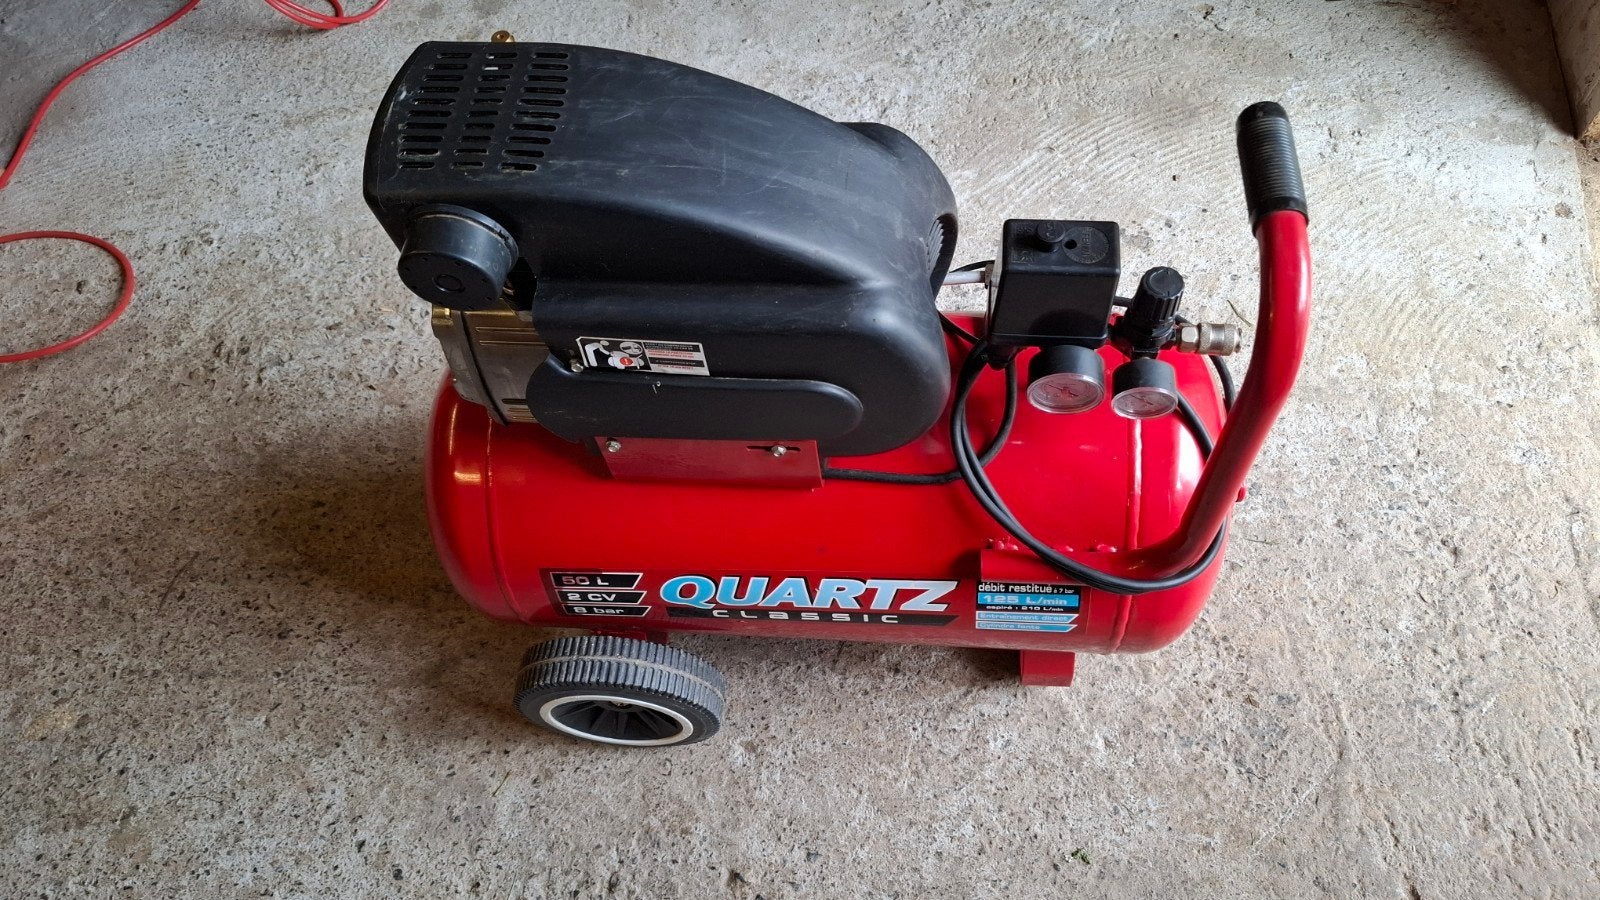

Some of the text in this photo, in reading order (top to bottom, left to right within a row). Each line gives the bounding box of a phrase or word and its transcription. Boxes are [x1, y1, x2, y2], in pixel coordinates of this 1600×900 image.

[561, 576, 609, 586] 50 L
[978, 581, 1006, 592] débit
[1008, 583, 1053, 593] restitué
[567, 593, 617, 602] 2 CV
[660, 575, 959, 612] QUARTZ
[983, 594, 1068, 606] 125 L/min
[573, 606, 588, 614] 8
[980, 613, 1040, 621] Entraînement
